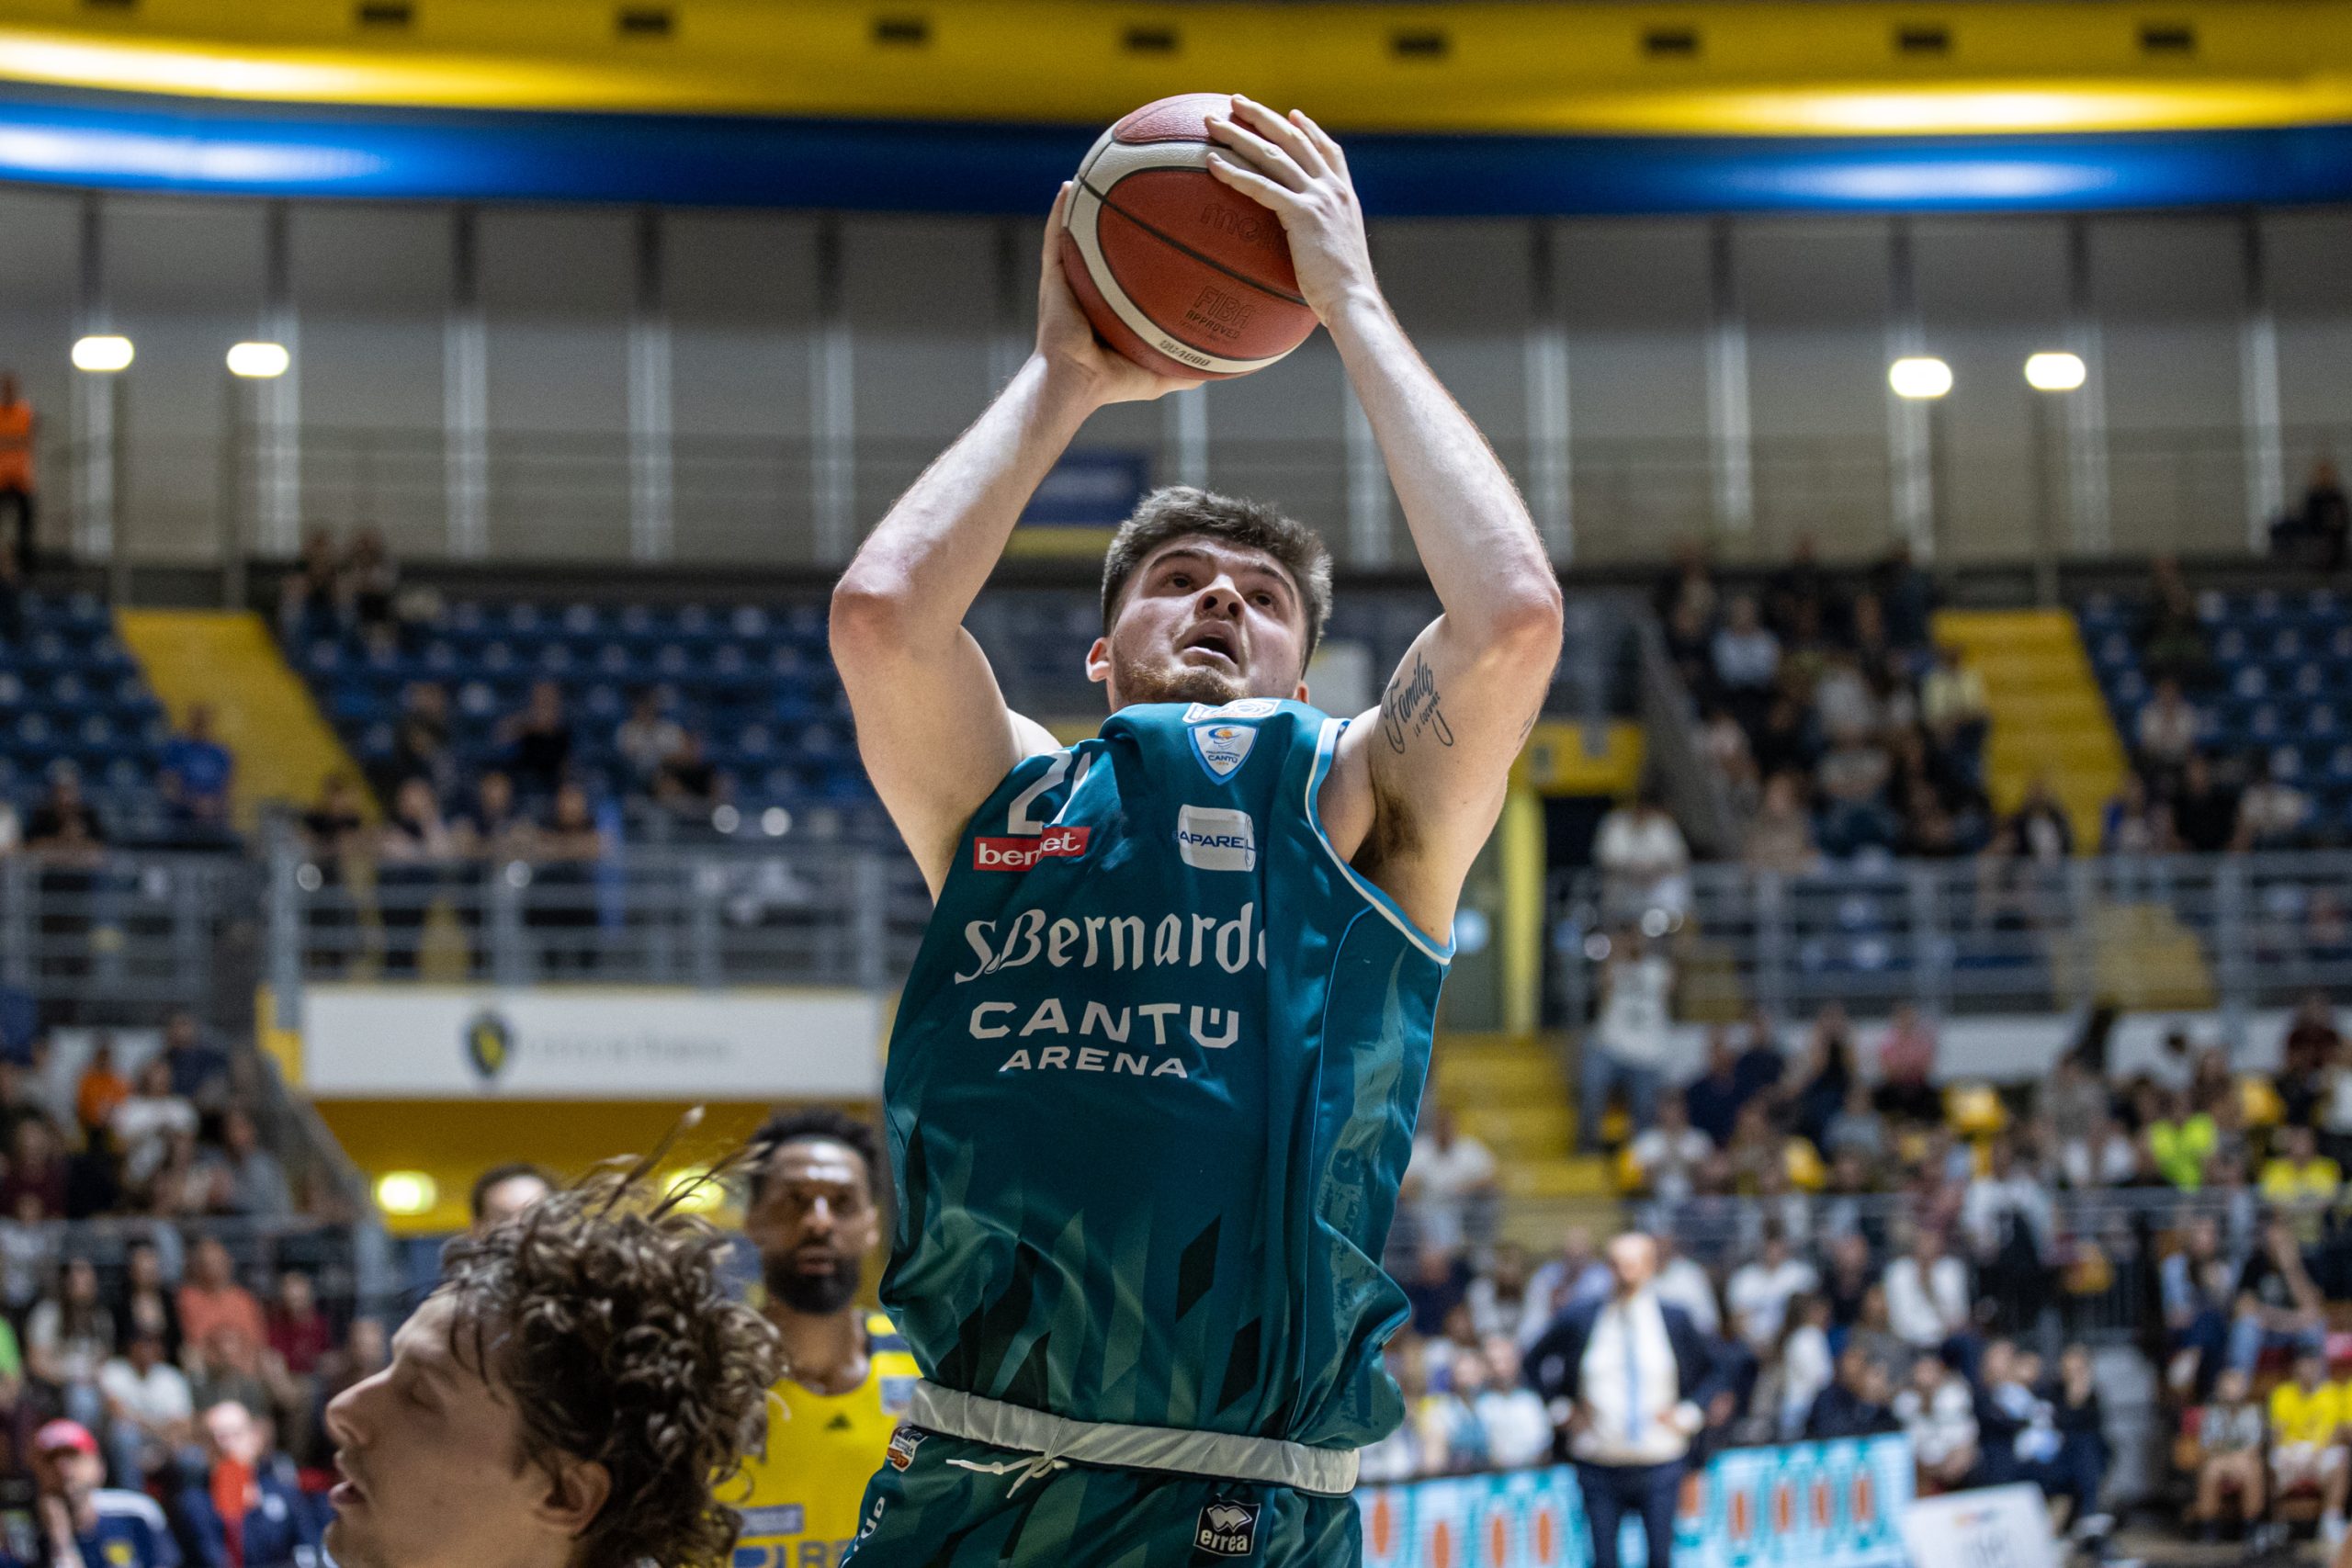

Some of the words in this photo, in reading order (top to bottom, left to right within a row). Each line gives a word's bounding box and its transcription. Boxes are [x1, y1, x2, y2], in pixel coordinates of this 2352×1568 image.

[1185, 310, 1240, 339] APPROVED
[1194, 286, 1256, 330] FIBA
[999, 1045, 1188, 1079] ARENA
